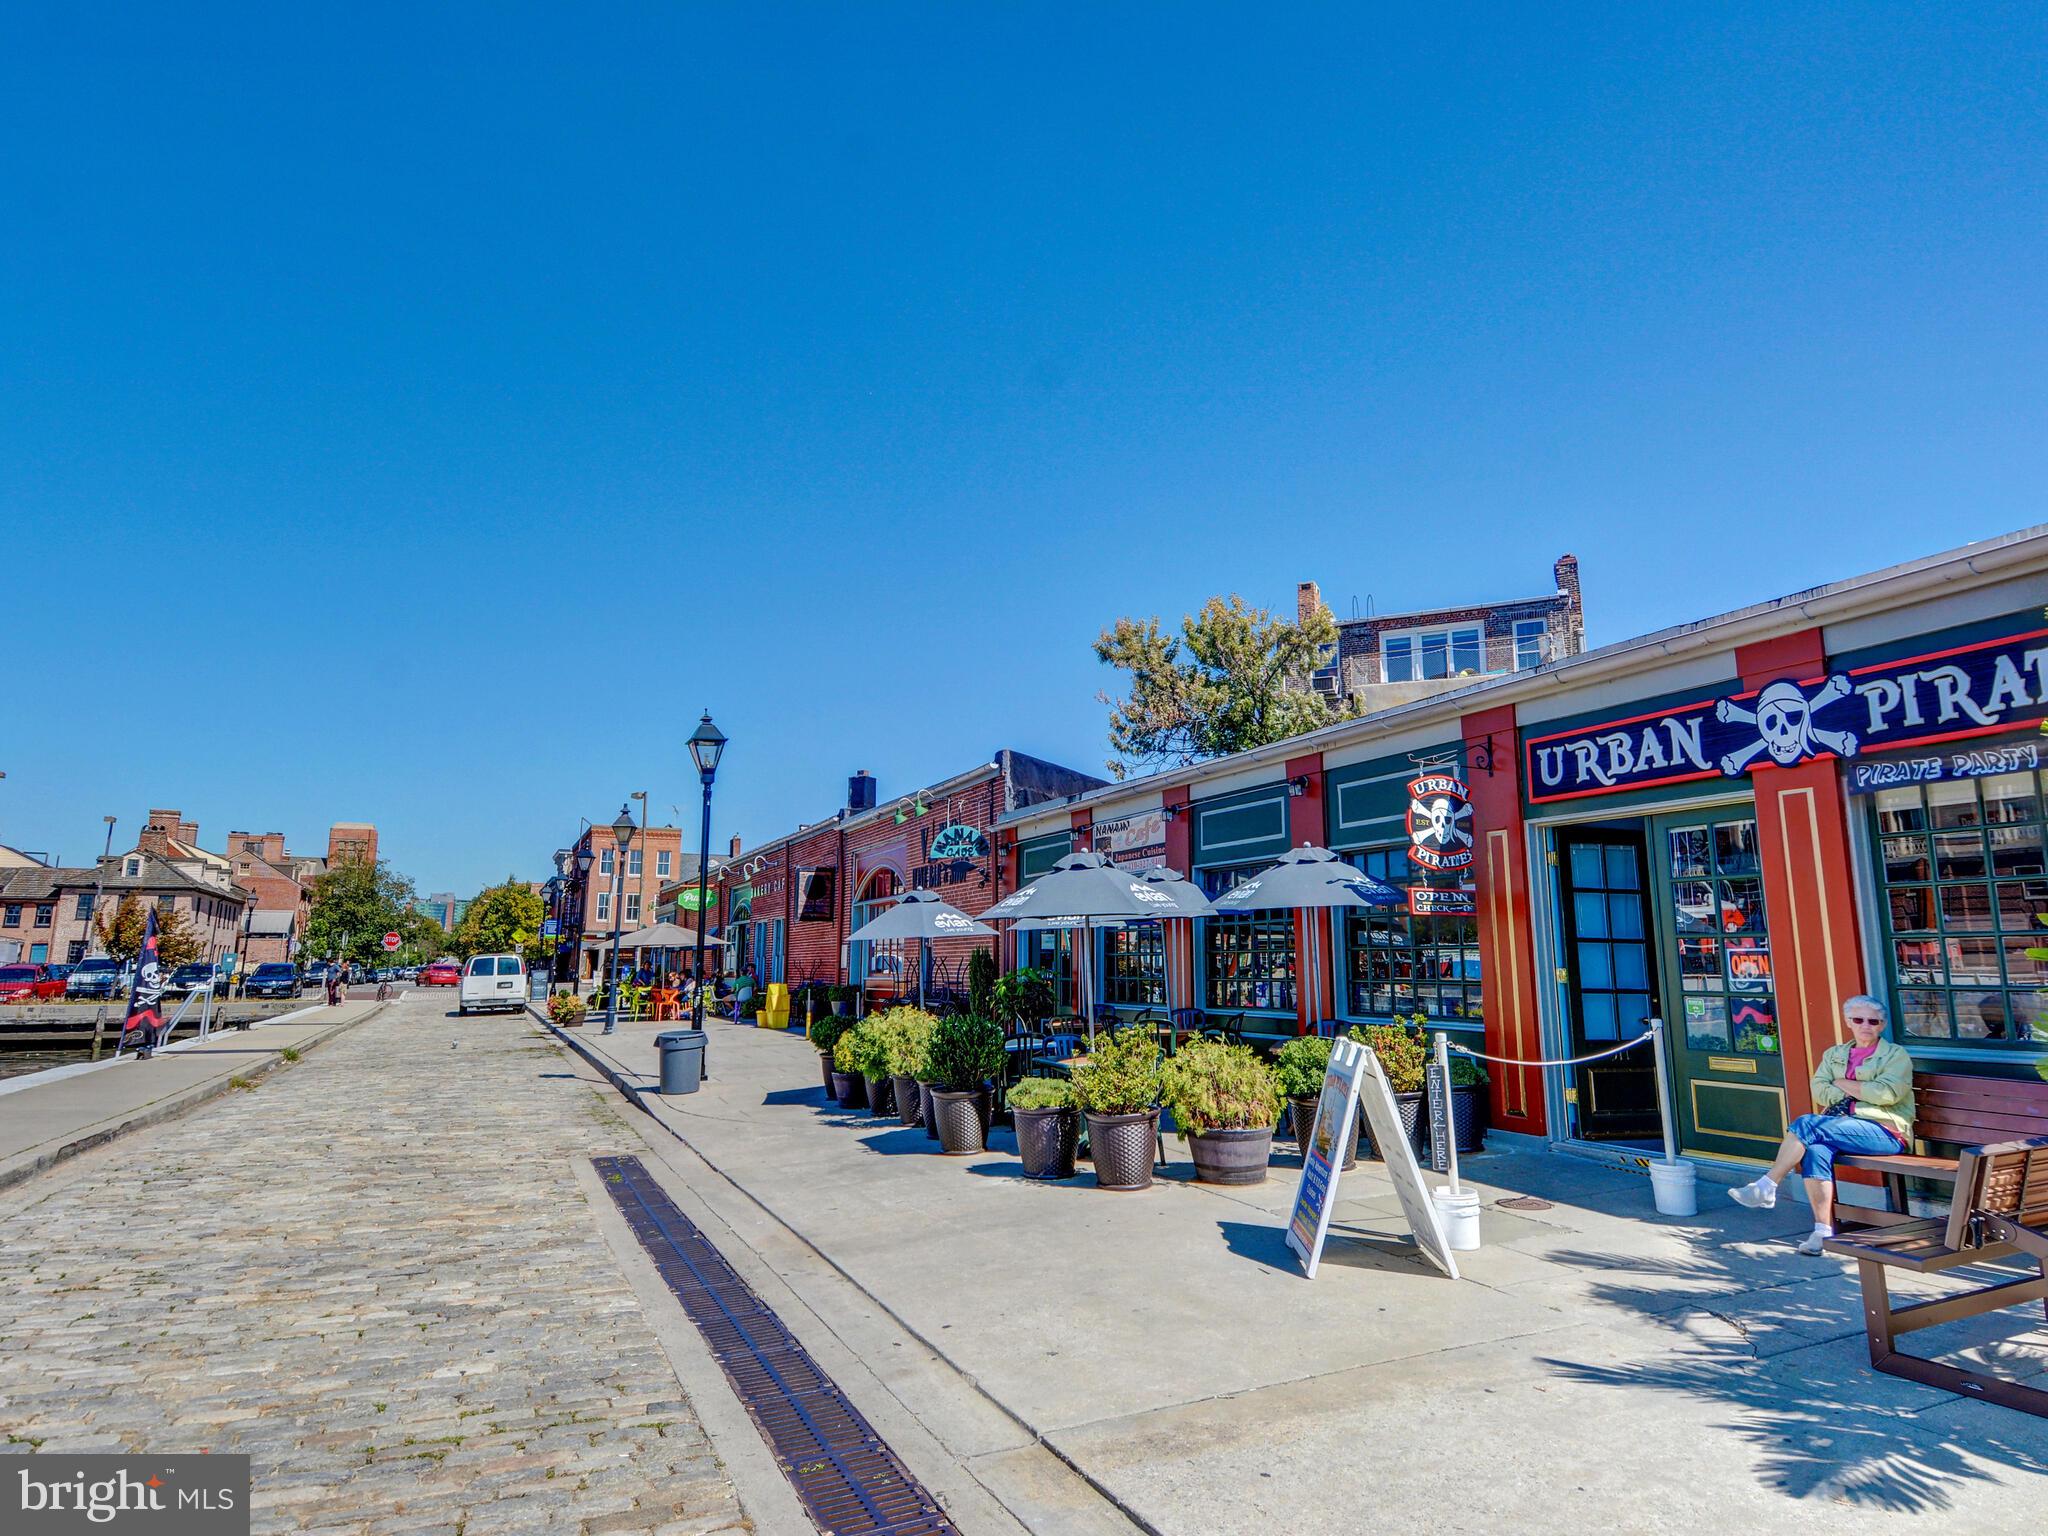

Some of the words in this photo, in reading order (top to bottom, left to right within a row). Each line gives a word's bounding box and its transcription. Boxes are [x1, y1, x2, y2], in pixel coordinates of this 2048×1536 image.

[1537, 717, 1713, 786] URBAN
[1857, 757, 1943, 787] PIRATE
[1952, 745, 2039, 777] PARTY
[1413, 778, 1470, 802] URBAN
[385, 935, 399, 943] STOP
[934, 919, 974, 928] evian
[1731, 954, 1770, 975] OPEN
[1430, 1067, 1443, 1121] ENTER
[1435, 1131, 1447, 1170] HERE
